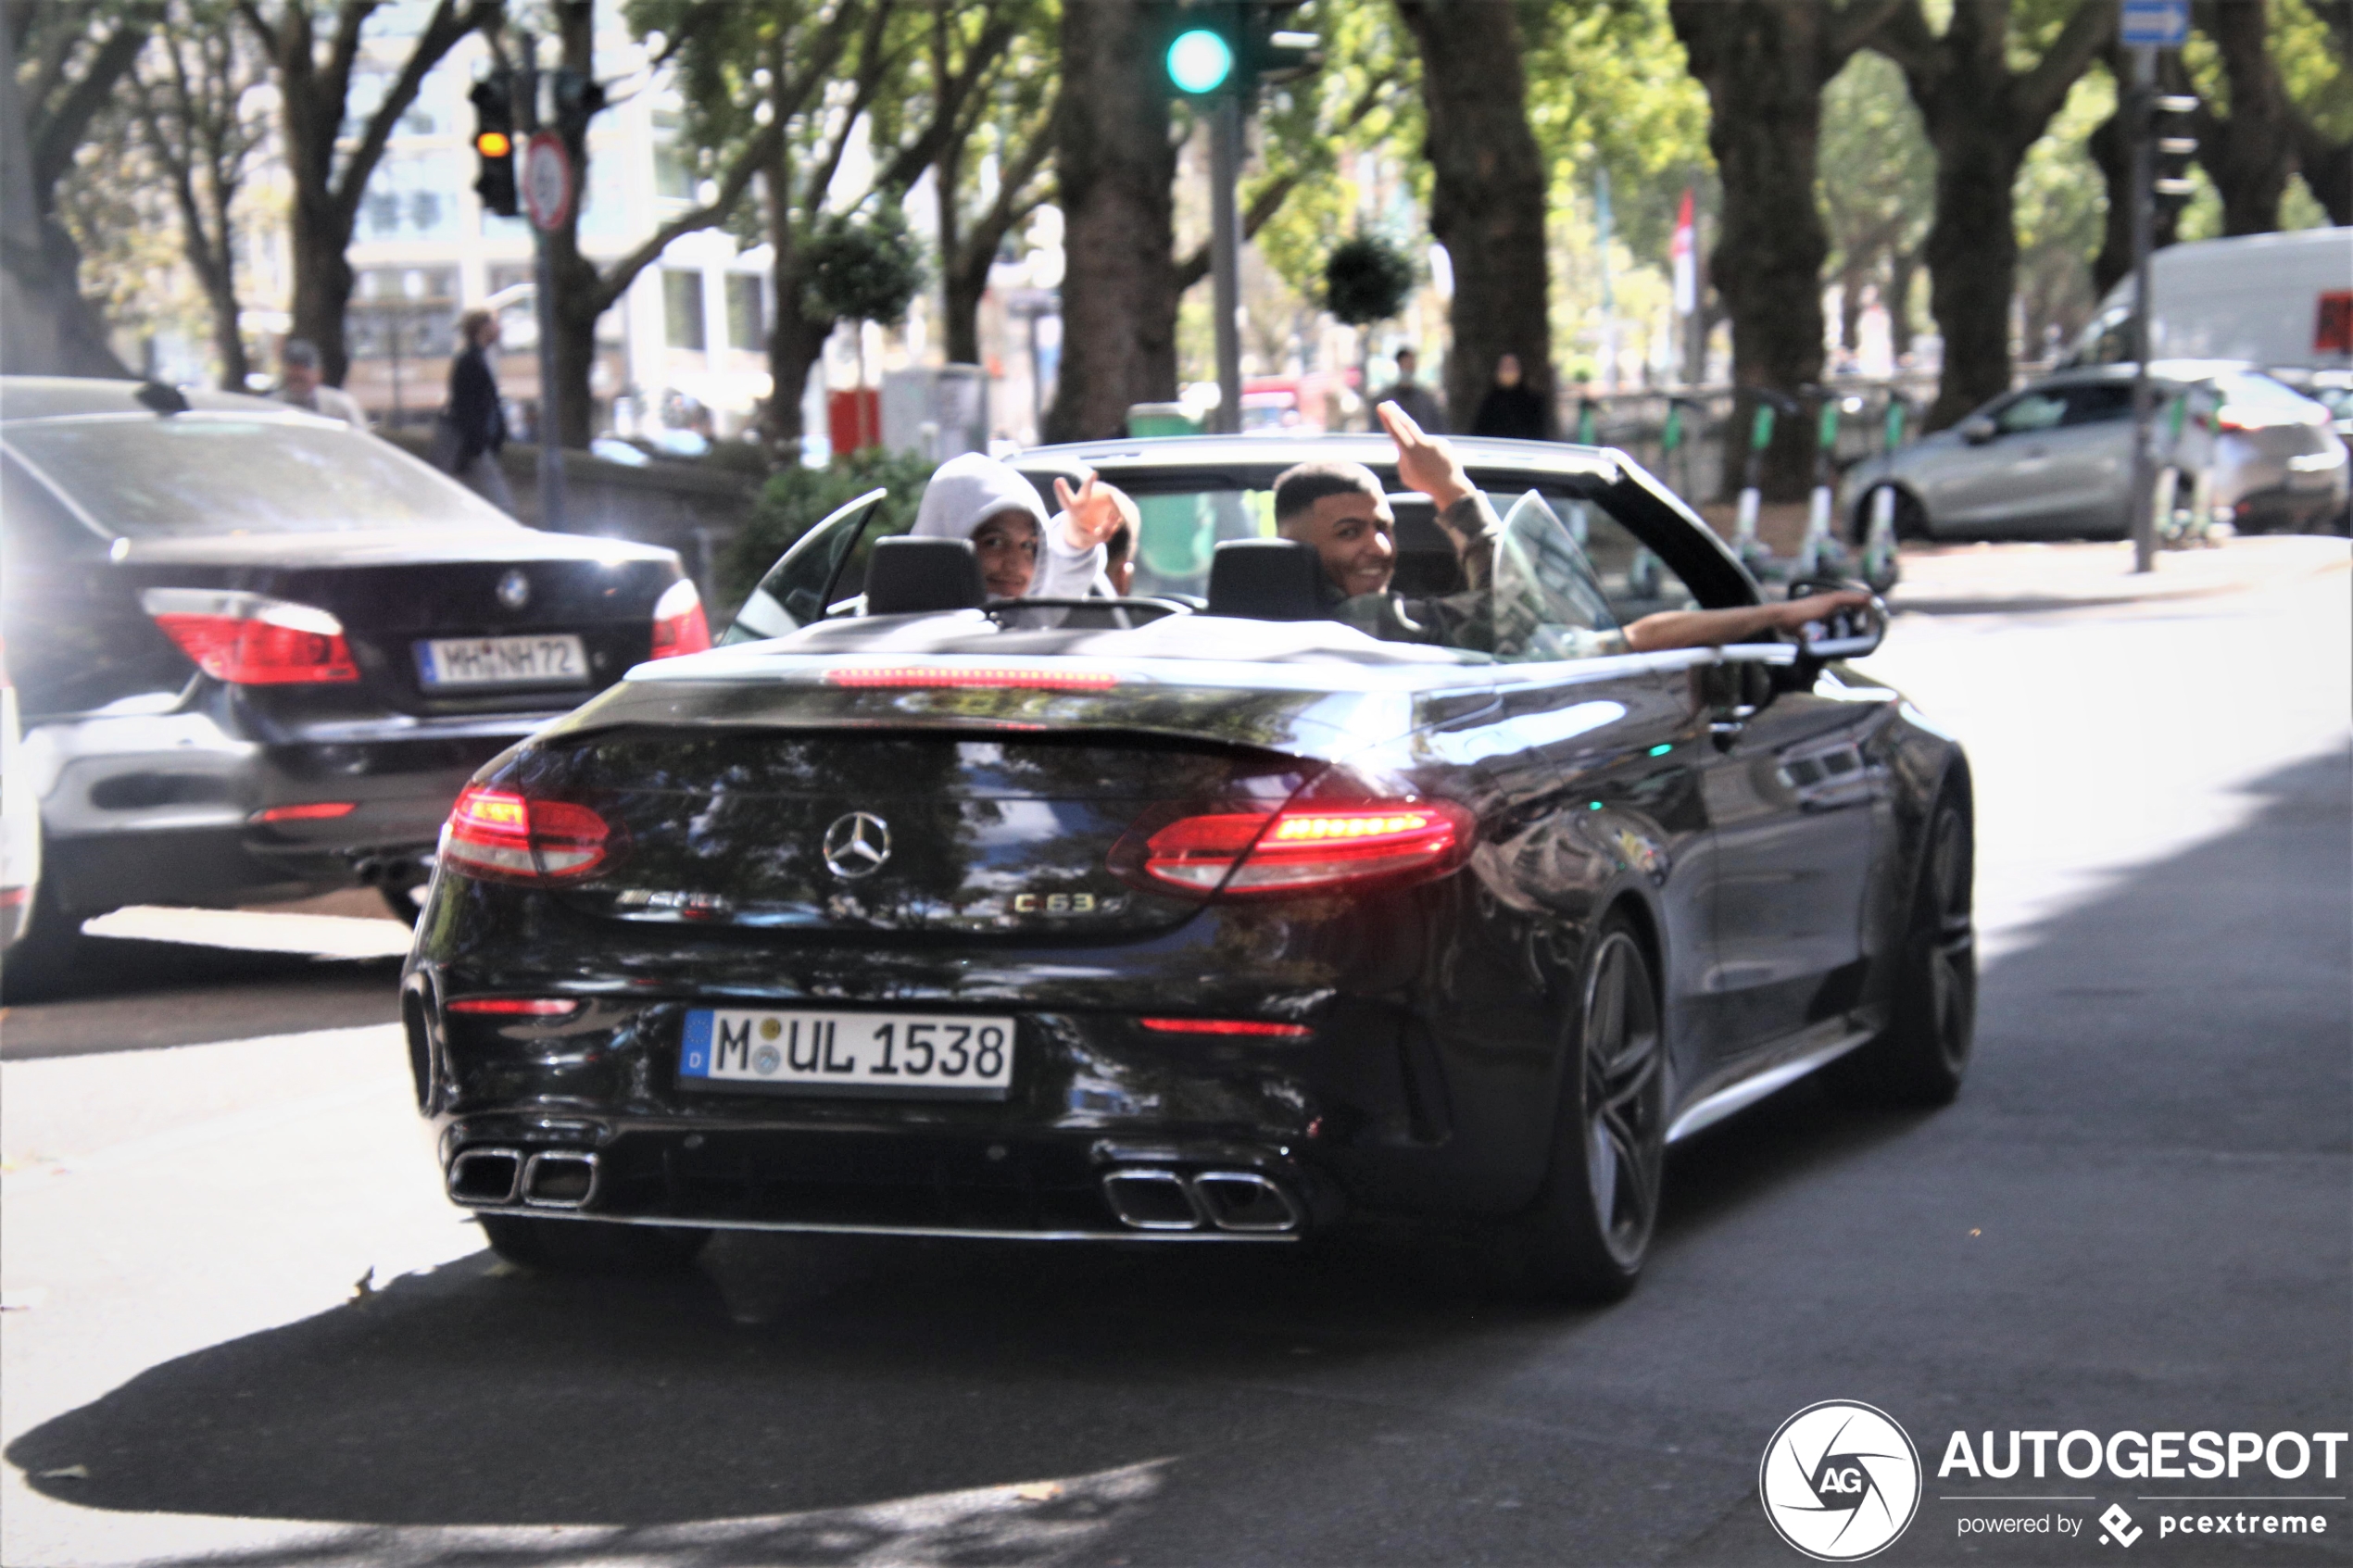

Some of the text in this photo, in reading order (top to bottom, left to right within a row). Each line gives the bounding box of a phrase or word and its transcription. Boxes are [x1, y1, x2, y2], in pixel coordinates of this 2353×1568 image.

[1014, 893, 1037, 913] C
[1046, 892, 1095, 913] 63
[716, 1018, 1006, 1079] M UL 1538
[689, 1053, 701, 1069] D
